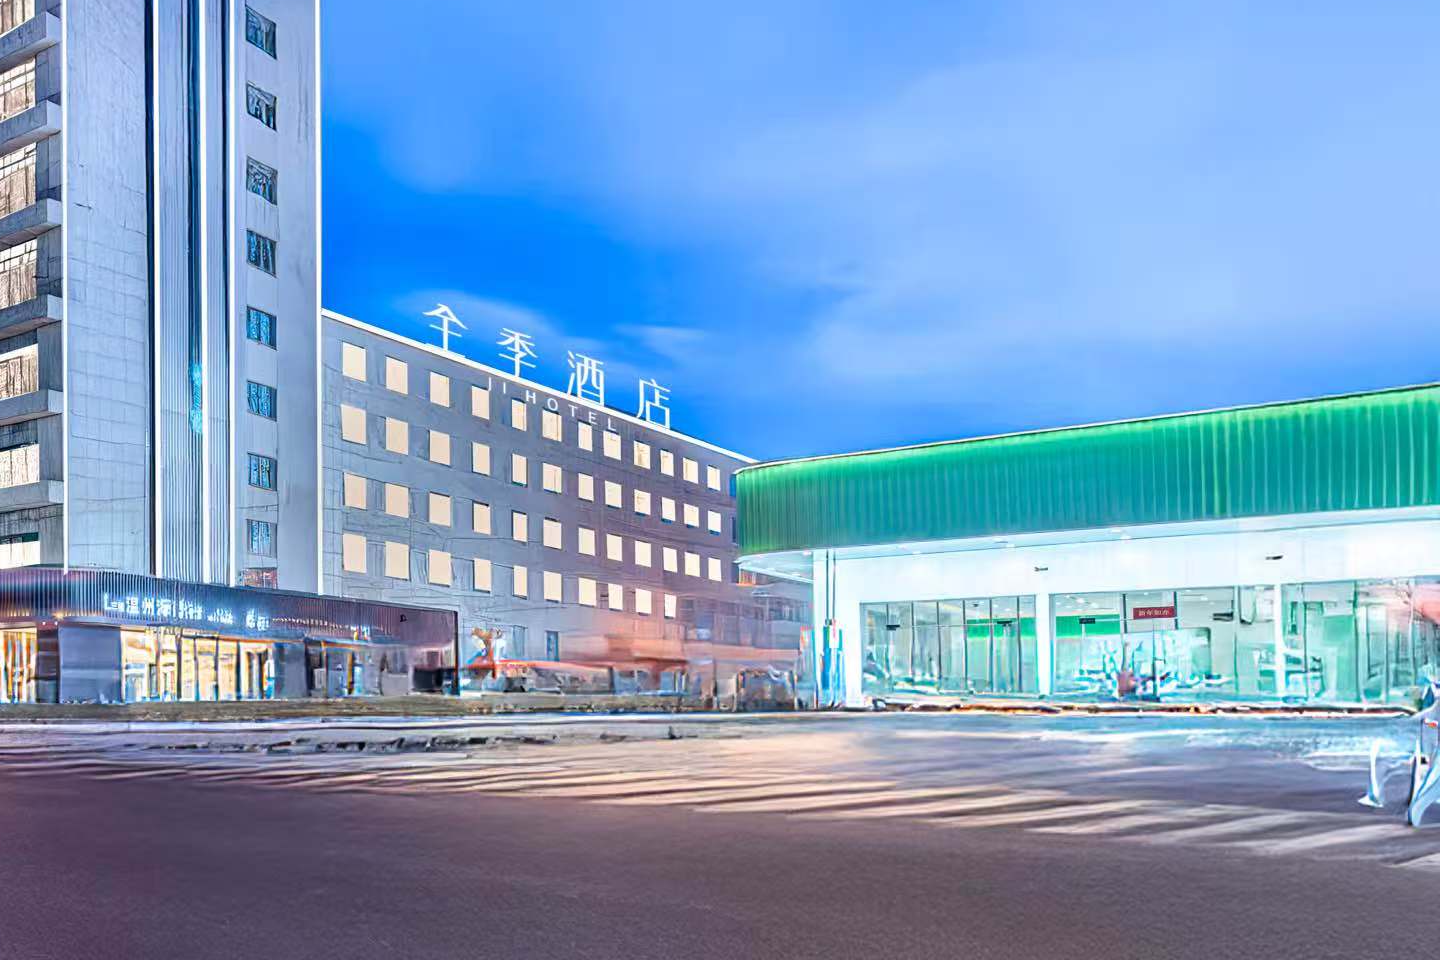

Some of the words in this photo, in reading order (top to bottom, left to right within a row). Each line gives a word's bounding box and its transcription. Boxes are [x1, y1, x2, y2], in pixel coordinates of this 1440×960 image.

[422, 303, 672, 430] 全季酒店
[487, 376, 507, 395] JI
[525, 389, 617, 432] HOTEL
